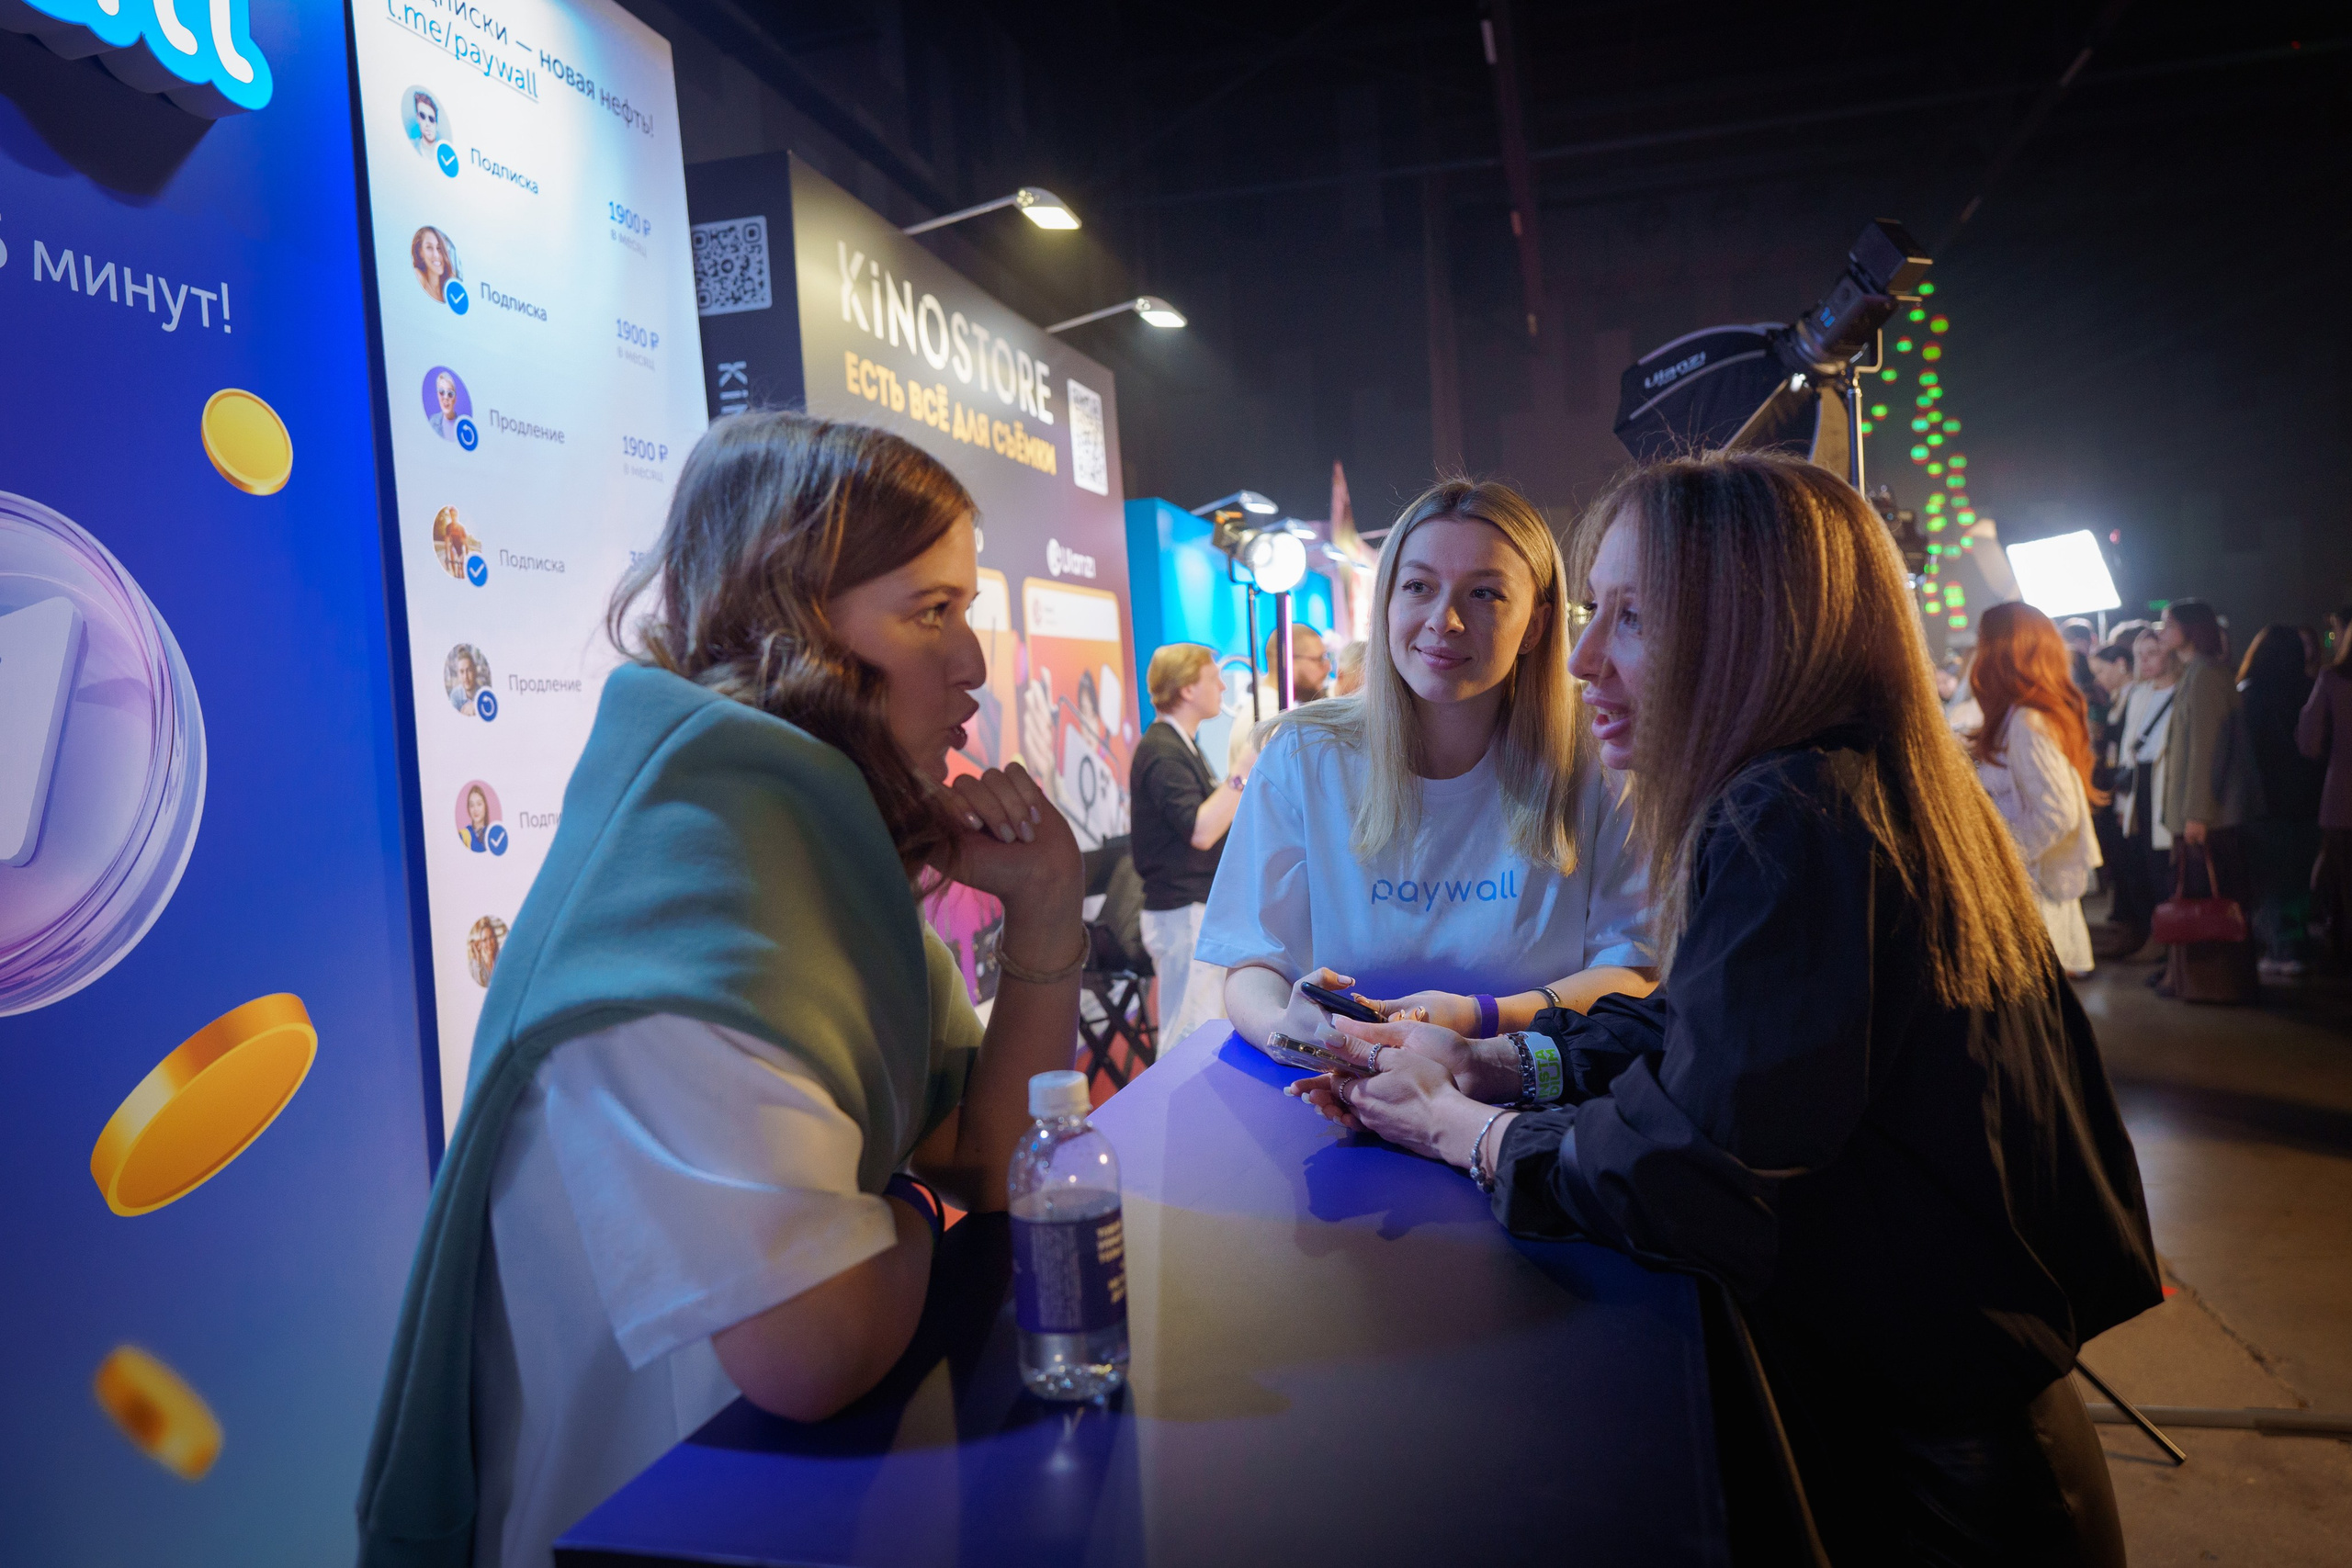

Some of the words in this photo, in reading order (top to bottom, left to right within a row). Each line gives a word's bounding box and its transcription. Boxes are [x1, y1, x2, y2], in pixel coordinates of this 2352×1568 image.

[540, 50, 595, 100] новая
[600, 87, 654, 138] нефть!
[470, 147, 538, 195] Подписка
[609, 201, 641, 234] 1900
[34, 239, 232, 334] минут!
[481, 281, 548, 322] Подписка
[616, 318, 648, 348] 1900
[844, 350, 906, 413] ЕСТЬ
[908, 378, 950, 434] ВСЁ
[952, 400, 990, 450] ДЛЯ
[490, 408, 566, 445] Продление
[623, 434, 656, 461] 1900
[499, 548, 566, 574] Подписка
[508, 673, 583, 696] Продление
[519, 811, 561, 829] Подпи
[1371, 869, 1519, 912] paywall
